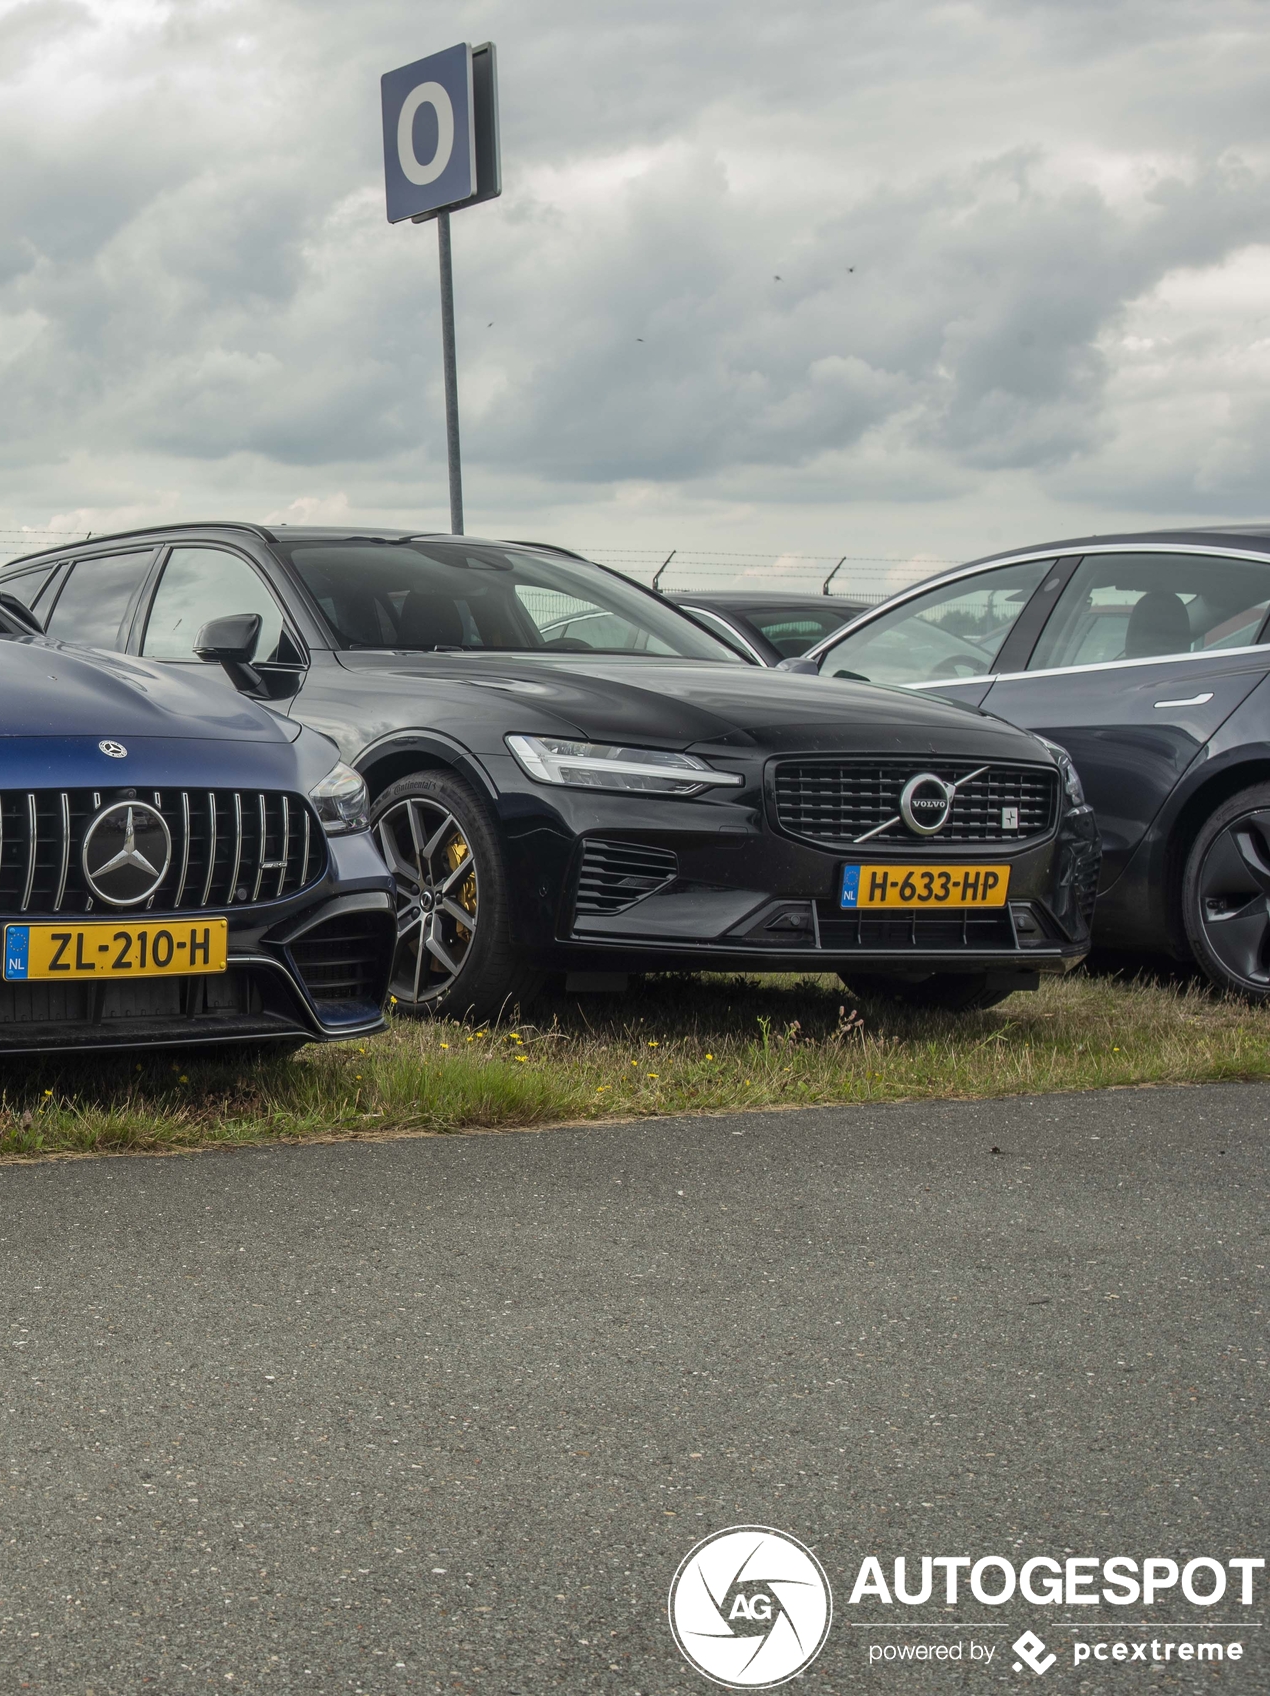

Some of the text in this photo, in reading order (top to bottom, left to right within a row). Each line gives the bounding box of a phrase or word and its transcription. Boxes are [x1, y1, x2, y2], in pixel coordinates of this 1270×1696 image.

[394, 781, 432, 796] Continental
[912, 800, 946, 808] VOLVO
[868, 871, 999, 902] H-633-HP
[843, 890, 856, 901] NL
[48, 928, 210, 971] ZL-210-H
[9, 958, 25, 970] NL
